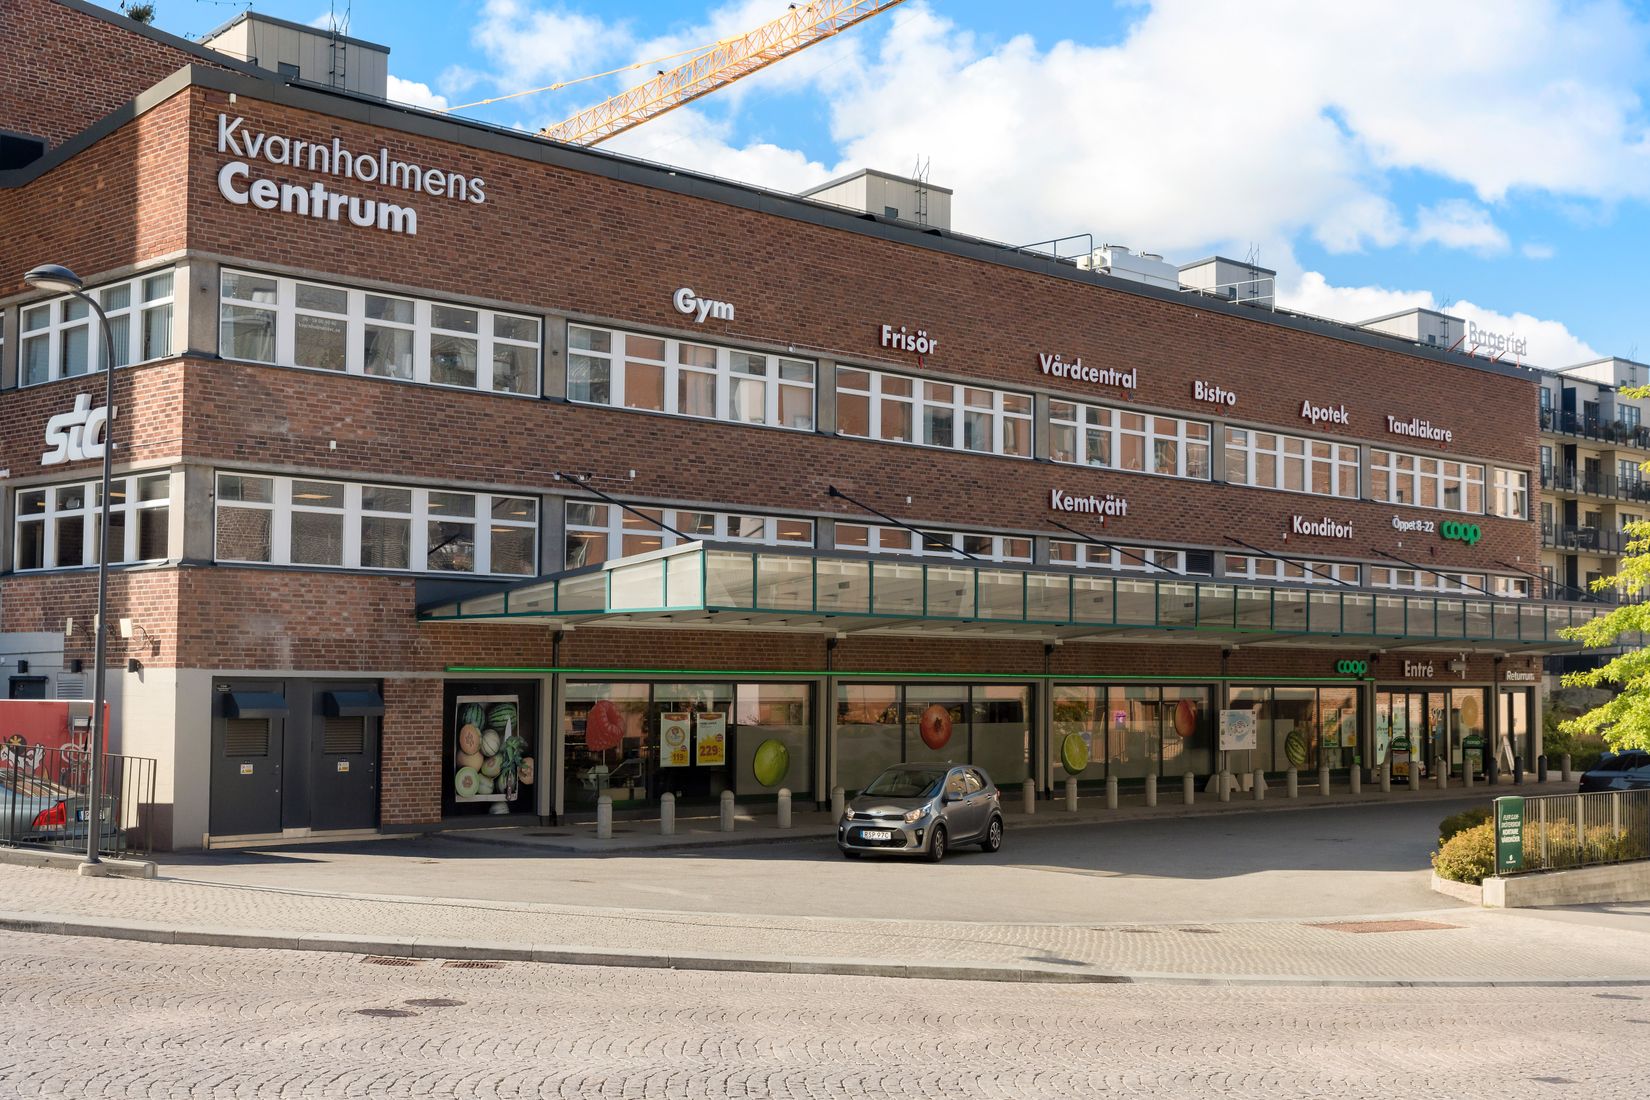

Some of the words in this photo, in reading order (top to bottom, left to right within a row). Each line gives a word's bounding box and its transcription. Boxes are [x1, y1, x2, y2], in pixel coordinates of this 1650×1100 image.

[218, 113, 486, 204] Kvarnholmens
[217, 161, 418, 235] Centrum
[673, 287, 735, 323] Gym
[882, 324, 938, 354] Frisör
[1469, 320, 1527, 356] Bageriet
[1039, 353, 1137, 389] Vårdcentral
[1194, 380, 1236, 406] Bistro
[1301, 400, 1349, 425] Apotek
[1387, 415, 1453, 442] Tandläkare
[1052, 489, 1128, 516] Kemtvätt
[1293, 515, 1353, 539] Konditori
[1392, 514, 1416, 532] Öppet
[1416, 520, 1435, 533] 8-22
[1442, 521, 1482, 545] coop
[1337, 659, 1368, 677] coop
[1404, 660, 1434, 678] Entré
